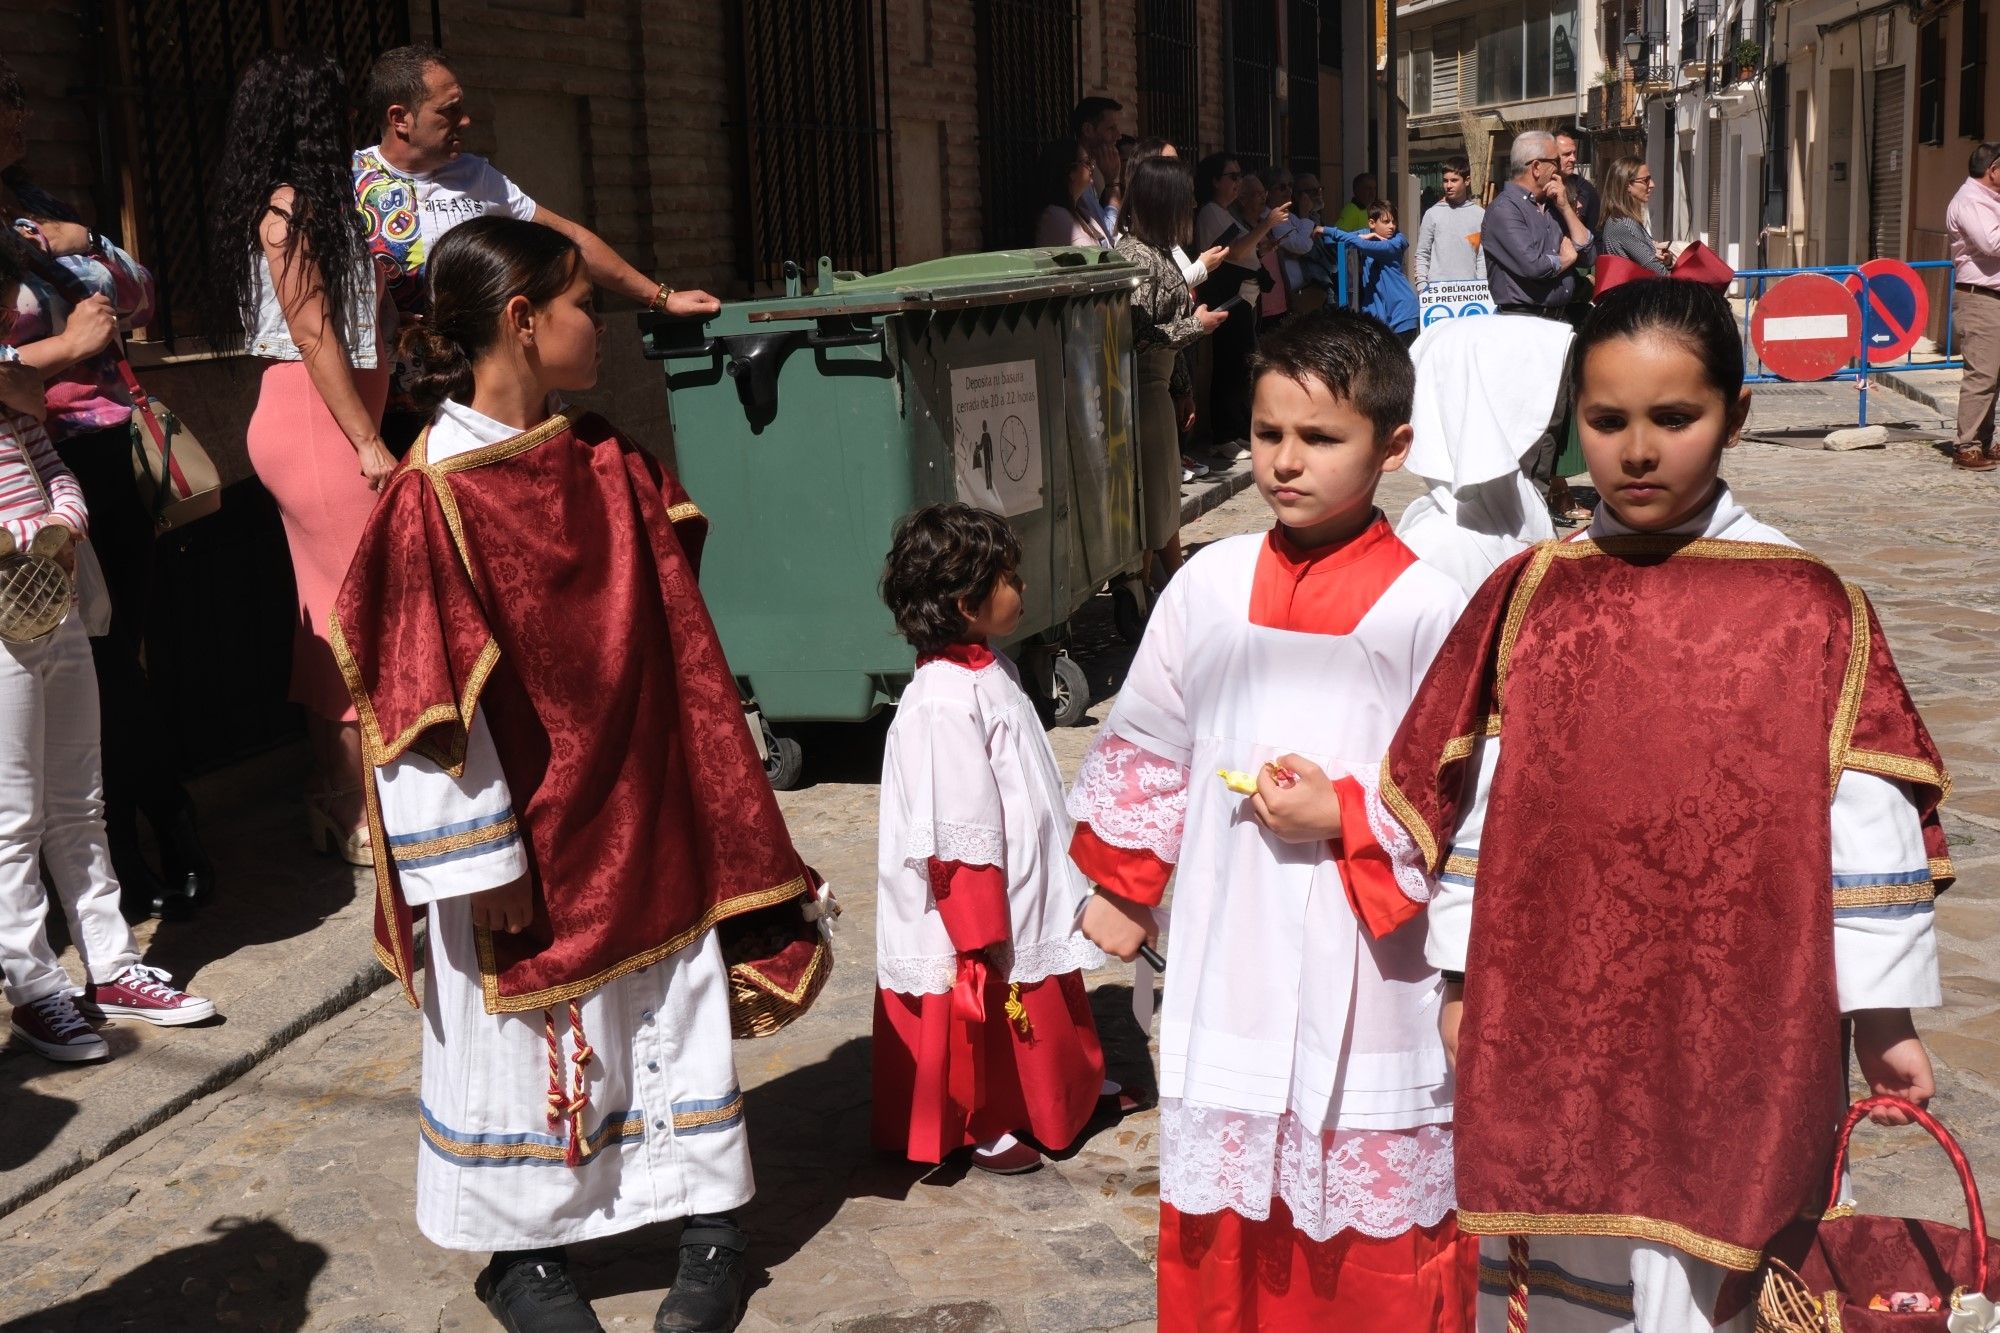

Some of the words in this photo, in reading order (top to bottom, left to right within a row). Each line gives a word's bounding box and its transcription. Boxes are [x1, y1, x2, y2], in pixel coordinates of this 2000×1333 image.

[1422, 296, 1433, 304] DE
[1001, 371, 1024, 385] basura
[956, 397, 980, 413] cerrada
[980, 394, 989, 408] de
[990, 392, 999, 407] 20
[1007, 391, 1016, 405] 22
[1017, 389, 1036, 404] horas
